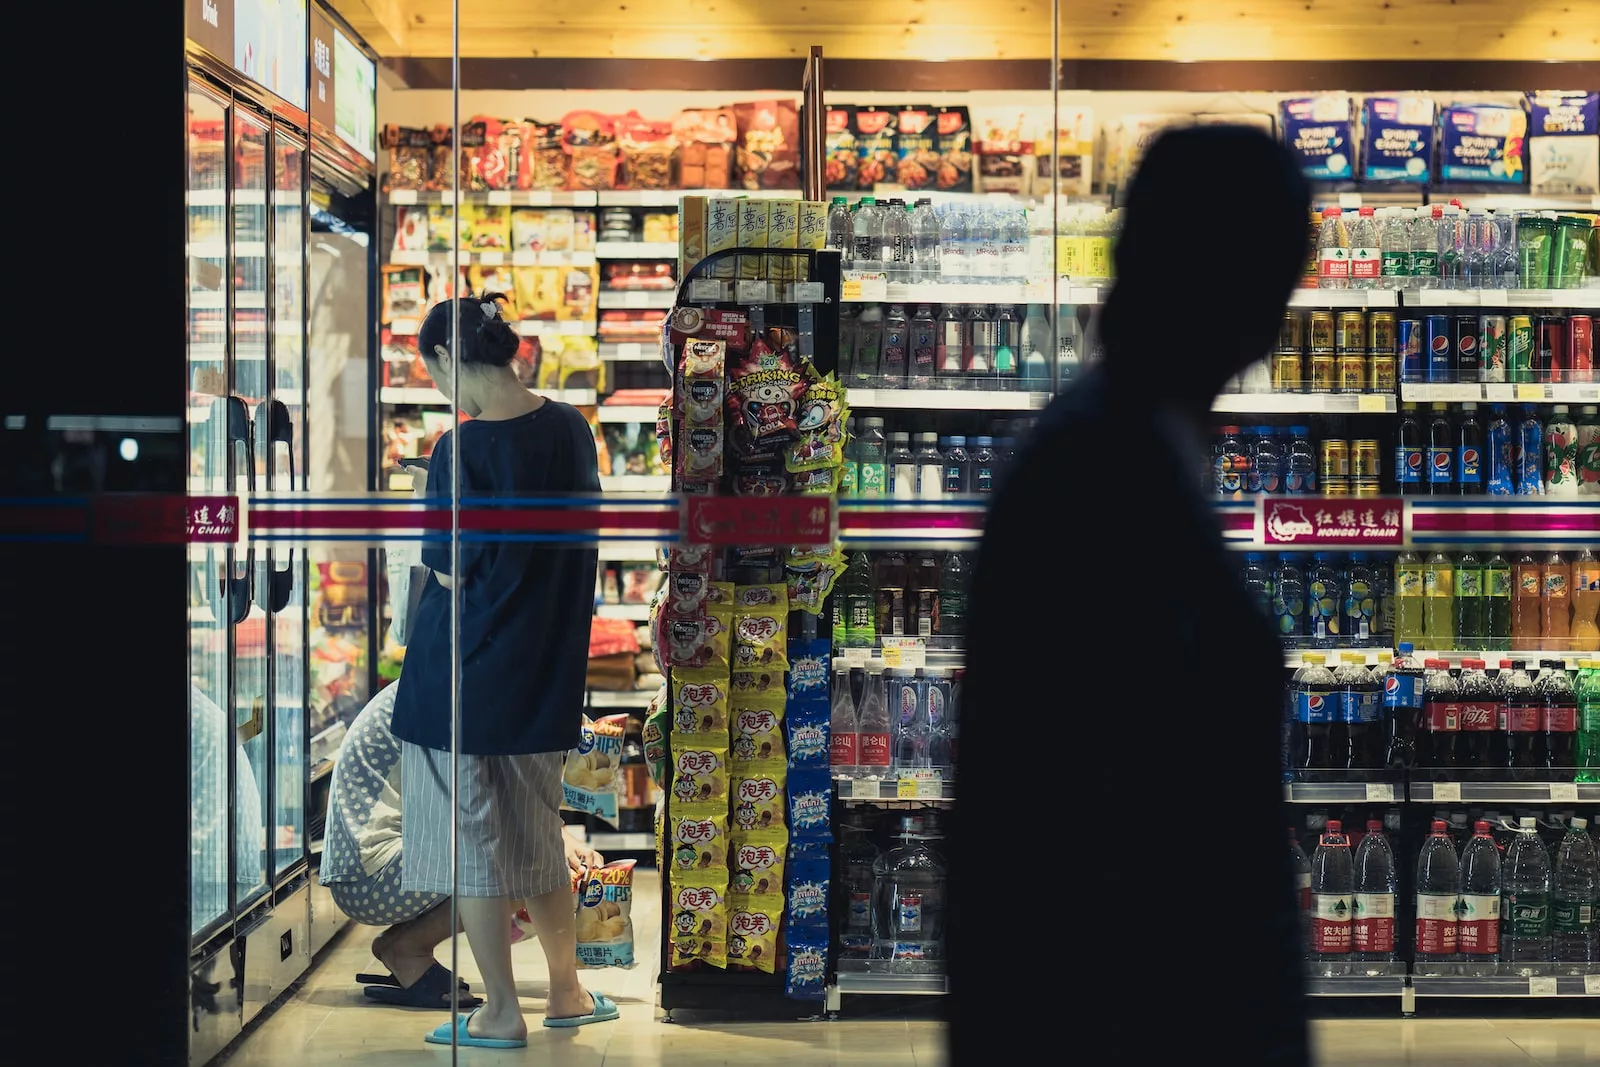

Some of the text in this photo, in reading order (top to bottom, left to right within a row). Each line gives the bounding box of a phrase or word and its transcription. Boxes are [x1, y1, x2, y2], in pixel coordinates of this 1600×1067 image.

[729, 370, 801, 392] STRIKING
[760, 421, 782, 433] COLA
[197, 526, 233, 535] CHAIN
[1316, 528, 1398, 537] HONGQI CHAIN
[742, 620, 774, 637] 泡芙
[798, 662, 819, 672] mini
[684, 686, 715, 703] 泡芙
[742, 713, 772, 729] 泡芙
[797, 731, 819, 741] mini
[683, 754, 714, 771] 泡芙
[742, 781, 773, 798] 泡芙
[800, 799, 821, 809] mini
[681, 823, 712, 839] 泡芙
[741, 849, 772, 866] 泡芙
[603, 868, 630, 886] 20%
[682, 889, 713, 907] 泡芙
[797, 889, 818, 899] mini
[735, 914, 767, 932] 泡芙
[797, 956, 818, 966] mini
